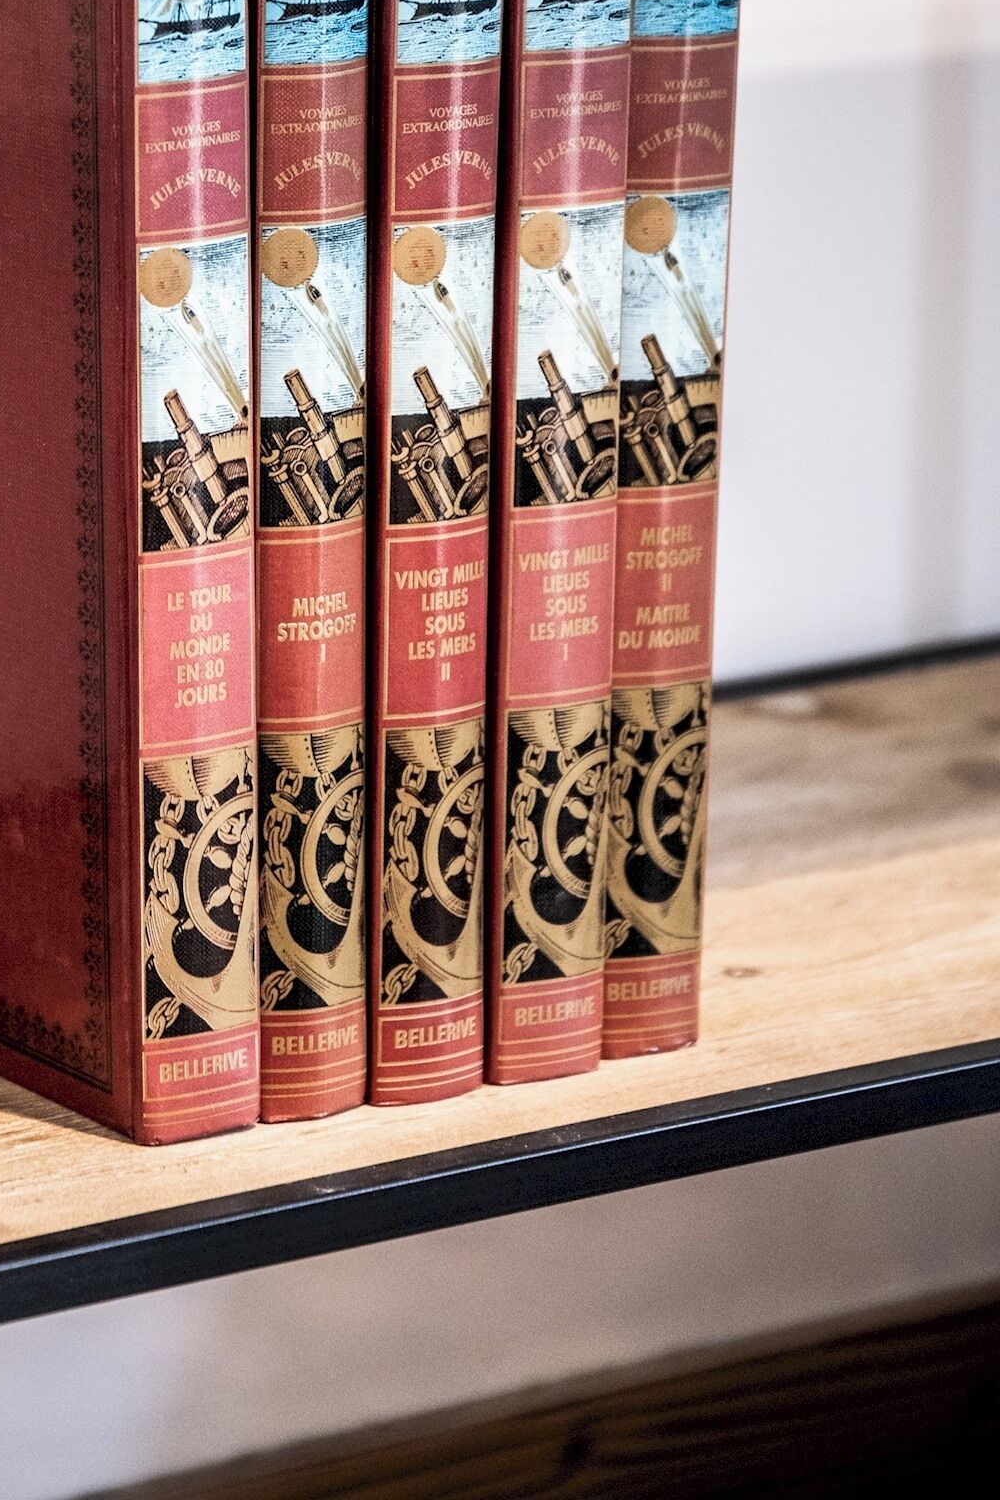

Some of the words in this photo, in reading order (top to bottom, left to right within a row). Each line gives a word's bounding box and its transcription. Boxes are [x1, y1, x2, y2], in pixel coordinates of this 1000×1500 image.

[556, 90, 604, 103] VOYAGES
[637, 88, 728, 104] EXTRAORDINAIRES
[664, 77, 711, 92] VOYAGES
[299, 104, 347, 120] VOYAGES
[429, 103, 478, 118] VOYAGES
[530, 100, 623, 120] EXTRAORDINAIRES
[171, 120, 221, 136] VOYAGES
[271, 115, 364, 135] EXTRAORDINAIRES
[402, 113, 495, 134] EXTRAORDINAIRES
[145, 130, 241, 154] EXTRAORDINAIRES
[638, 122, 686, 158] JULES
[687, 122, 726, 151] VERNE
[532, 137, 578, 174] JULES
[579, 136, 621, 166] VERNE
[273, 154, 322, 191] JULES
[322, 149, 363, 181] VERNE
[404, 153, 450, 190] JULES
[452, 149, 493, 180] VERNE
[149, 169, 196, 210] JULES
[196, 167, 241, 198] VERNE
[640, 524, 692, 546] MICHEL
[518, 549, 569, 572] VINGT
[574, 542, 610, 565] MILLE
[625, 546, 702, 570] STROGOFF
[394, 567, 449, 590] VINGT
[453, 559, 485, 585] MILLE
[543, 570, 590, 593] LIEUES
[661, 573, 672, 592] II
[167, 591, 185, 612] LE
[190, 583, 232, 607] TOUR
[292, 591, 348, 618] MICHEL
[421, 587, 469, 612] LIEUES
[545, 594, 587, 617] SOUS
[190, 612, 213, 634] DU
[277, 613, 356, 642] STROGOFF
[424, 611, 466, 636] SOUS
[529, 623, 556, 642] LES
[560, 615, 599, 638] MERS
[169, 633, 231, 660] MONDE
[408, 639, 436, 660] LES
[440, 632, 476, 657] MERS
[618, 631, 643, 650] DU
[648, 625, 701, 648] MONDE
[320, 643, 326, 663] I
[562, 643, 569, 662] I
[177, 663, 200, 684] EN
[204, 657, 225, 679] 80
[440, 661, 451, 682] II
[174, 682, 227, 709] JOURS
[607, 975, 691, 1001] BELLERIVE
[514, 995, 595, 1027] BELLERIVE
[271, 1026, 358, 1056] BELLERIVE
[394, 1014, 477, 1049] BELLERIVE
[159, 1048, 248, 1083] BELLERIVE
